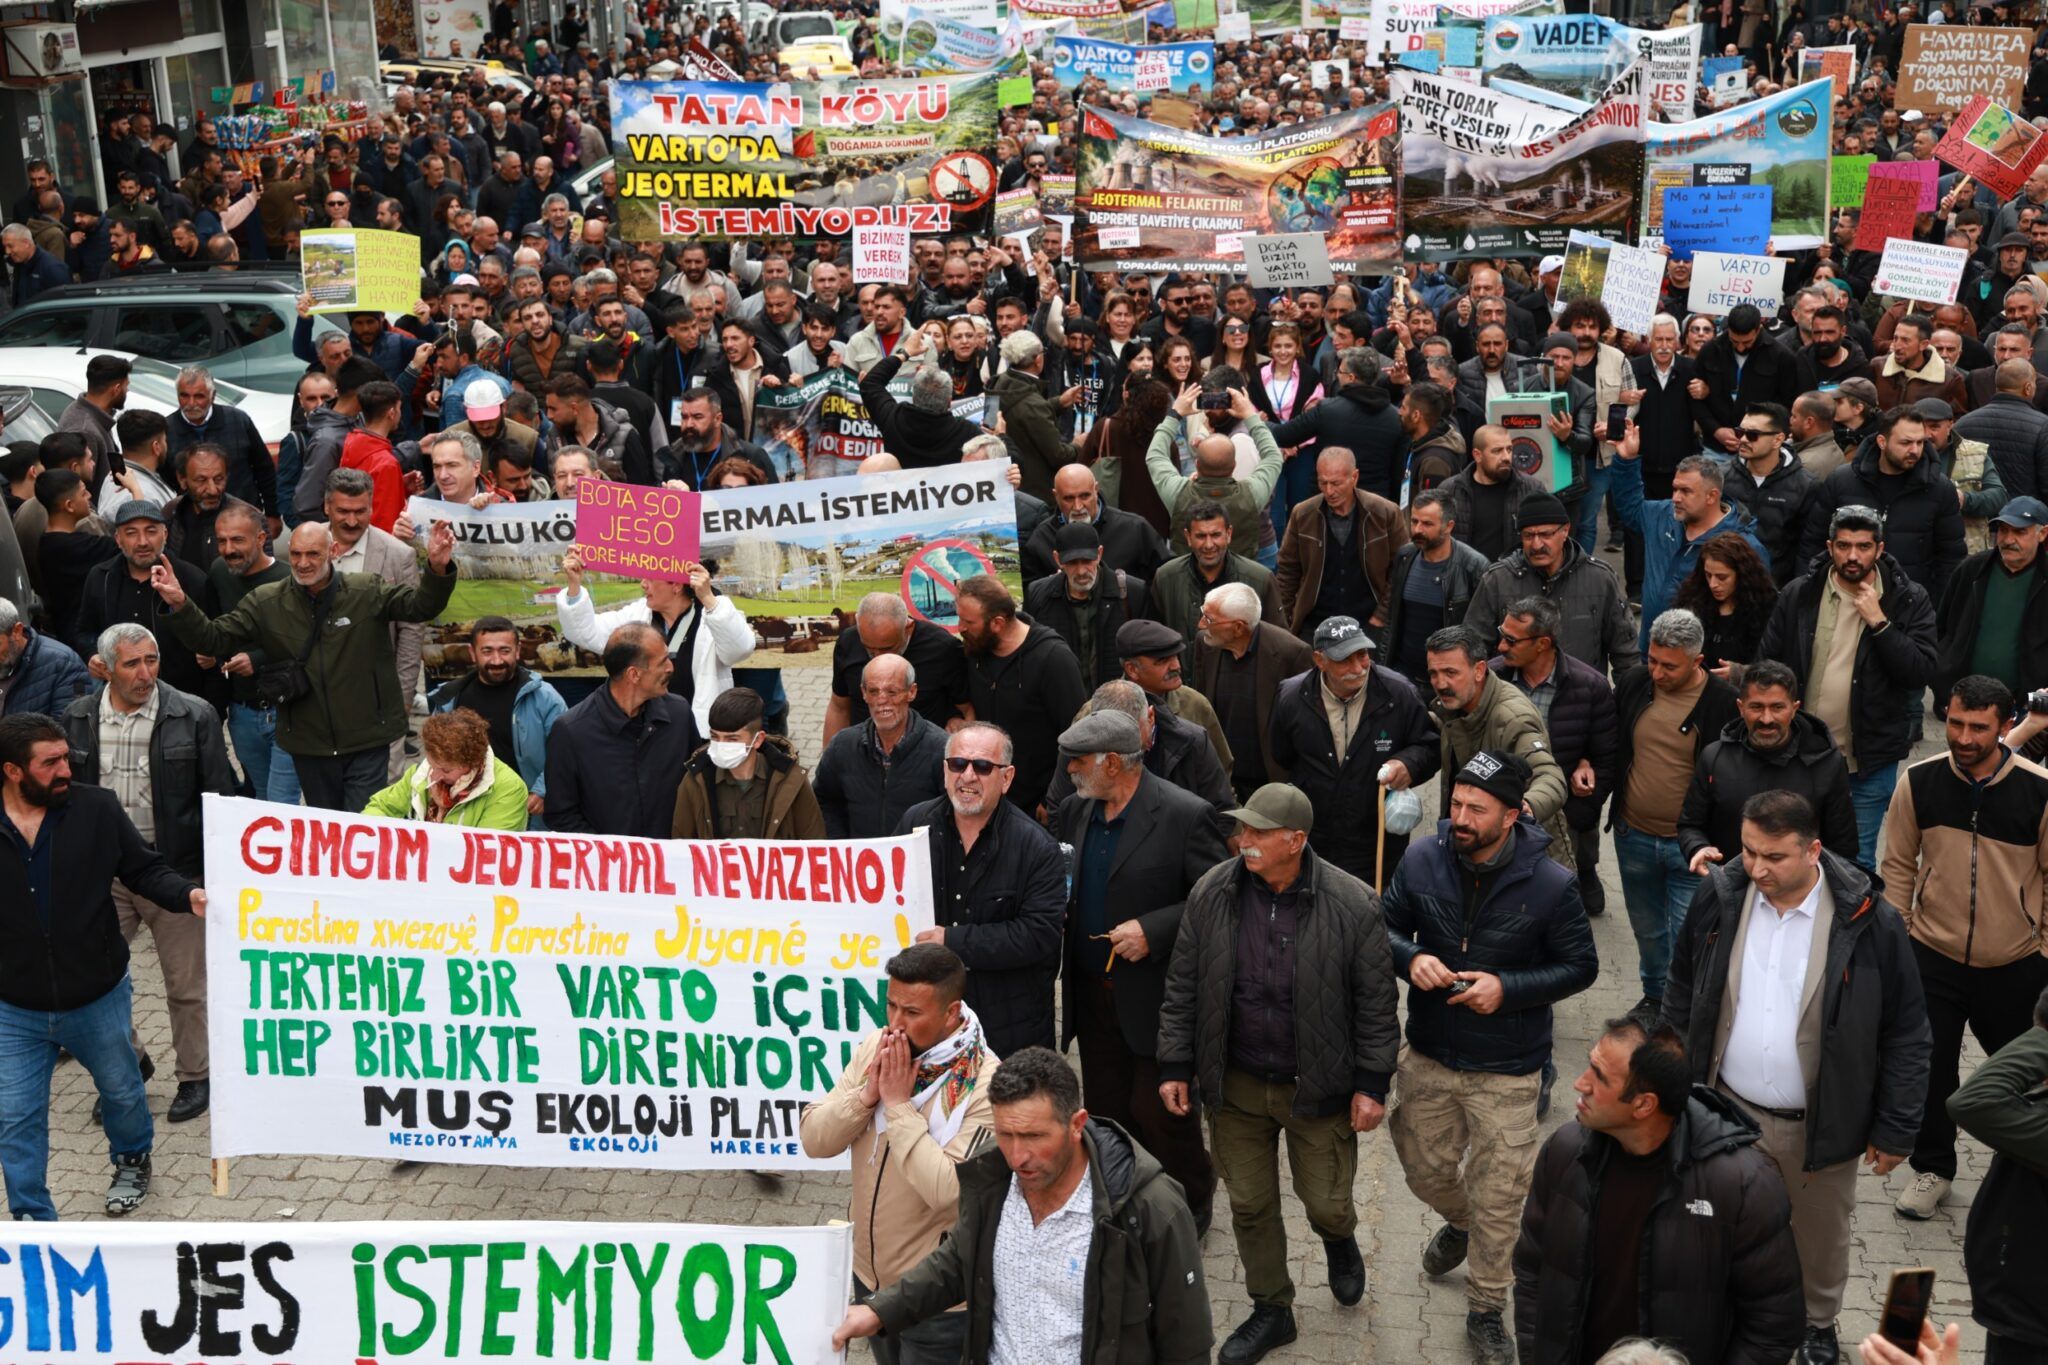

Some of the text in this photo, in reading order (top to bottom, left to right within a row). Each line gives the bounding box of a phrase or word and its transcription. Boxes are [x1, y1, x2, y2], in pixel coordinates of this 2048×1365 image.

[1534, 22, 1609, 46] VADEF
[1919, 31, 2026, 53] HAVAMIZA
[1074, 45, 1184, 65] VARTO JES'E
[1653, 47, 1691, 57] DOKUNMA
[1138, 63, 1166, 76] JES'E
[1651, 71, 1688, 80] KURUTMA
[1136, 78, 1169, 90] HAYIR
[1650, 83, 1686, 103] JES
[1913, 78, 2006, 96] DOKUNMA
[653, 83, 949, 126] TATAN KÖYÜ
[1446, 88, 1499, 119] TORAK
[830, 136, 932, 152] DOĞAMIZA DOKUNMA!
[1264, 126, 1332, 150] PLATFORMU
[627, 135, 782, 163] VARTO'DA
[1274, 139, 1344, 162] PLATFORMU
[1520, 141, 1555, 160] JES
[620, 172, 796, 200] JEOTERMAL
[1092, 193, 1243, 212] JEOTERMAL FELAKETTİR!
[659, 202, 951, 236] İSTEMİYORUZ!
[1089, 211, 1244, 231] DEPREME DAVETİYE ÇIKARMA!
[1258, 239, 1299, 255] DOĞA
[1888, 242, 1938, 256] JEOTERMALE
[1938, 249, 1965, 260] HAYIR
[1116, 260, 1181, 273] TOPRAĞIMA,
[1183, 263, 1231, 272] SUYUMA,
[1264, 262, 1307, 273] VARTO
[1720, 257, 1771, 276] VARTO
[1720, 275, 1753, 294] JES
[369, 290, 410, 305] HAYIR
[579, 480, 682, 519] BOTA ŞO
[532, 512, 577, 543] KÖ
[703, 501, 816, 533] ERMAL
[823, 480, 997, 522] İSTEMİYOR
[576, 543, 617, 564] TORE
[240, 815, 429, 883] GIMGIM
[237, 887, 360, 943] Parastina
[370, 912, 480, 956] xwezayê,
[489, 894, 630, 956] Parastina
[239, 948, 889, 1037] TERTEMİZ BİR VARTO İÇİN
[243, 1018, 332, 1077] HEP
[352, 1020, 540, 1084] BİRLİKTE
[362, 1085, 811, 1140] MUŞ EKOLOJİ PLAT
[388, 1131, 800, 1156] MEZOPOTAMYA EKOLOJİ HAREKE
[140, 1240, 301, 1357] JES
[351, 1242, 797, 1365] İSTEMİYOR
